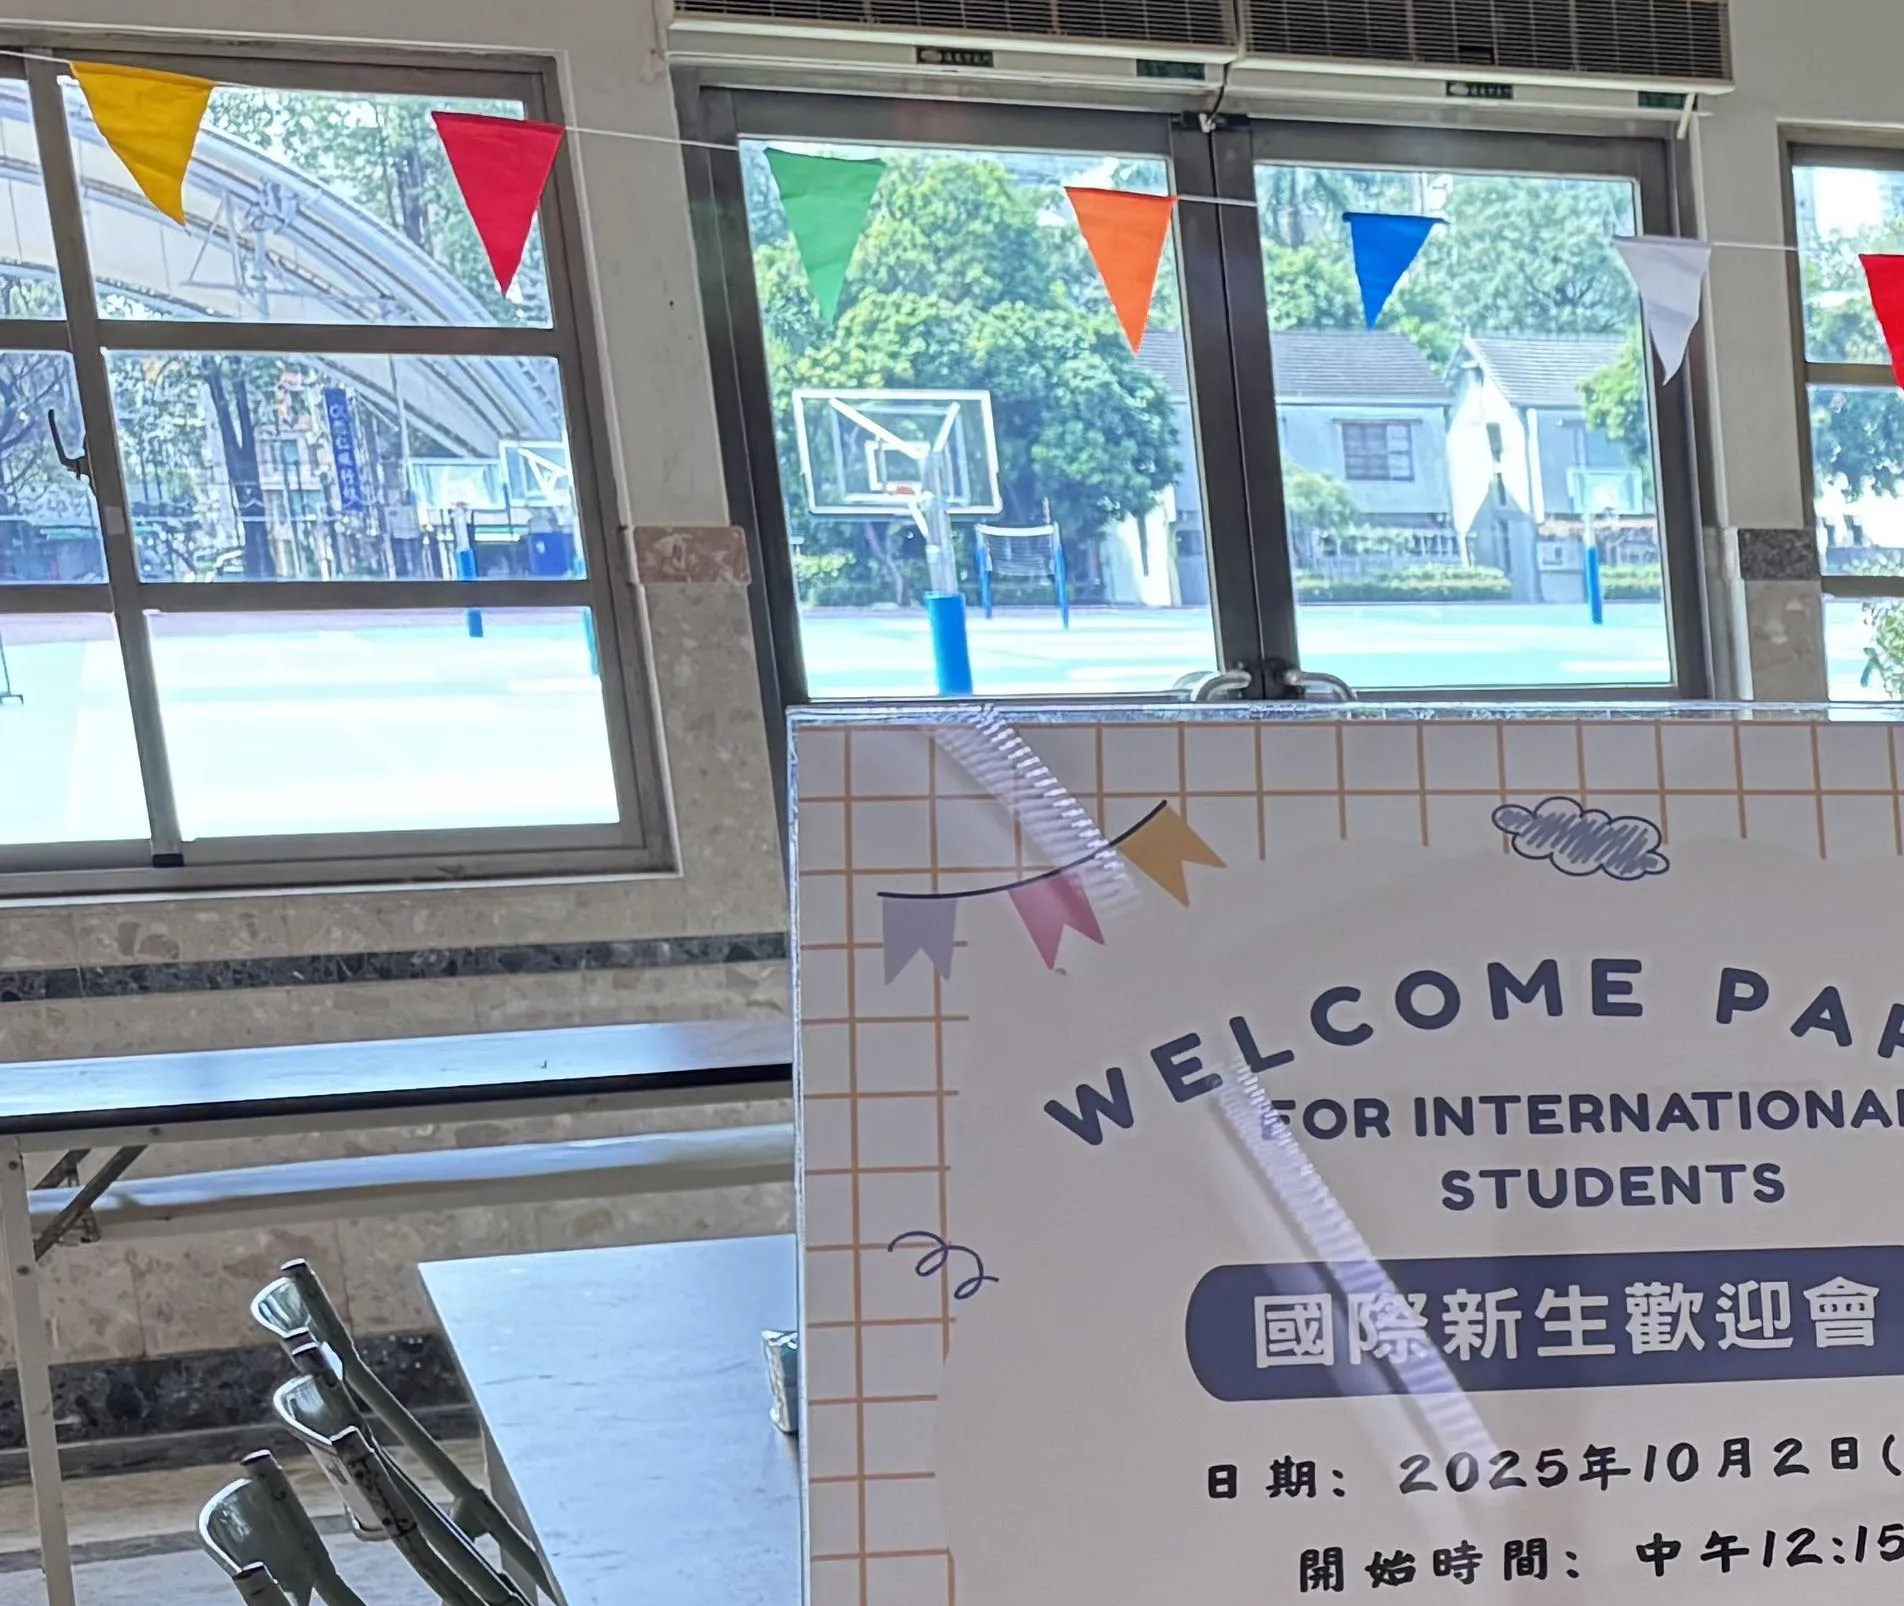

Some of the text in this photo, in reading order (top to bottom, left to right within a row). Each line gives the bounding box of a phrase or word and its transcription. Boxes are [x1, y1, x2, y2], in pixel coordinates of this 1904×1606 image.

[1044, 956, 1643, 1145] WELCOME
[1260, 1098, 1390, 1140] FOR
[1442, 1163, 1784, 1210] STUDENTS
[1255, 1276, 1879, 1368] 國際新生歡迎會
